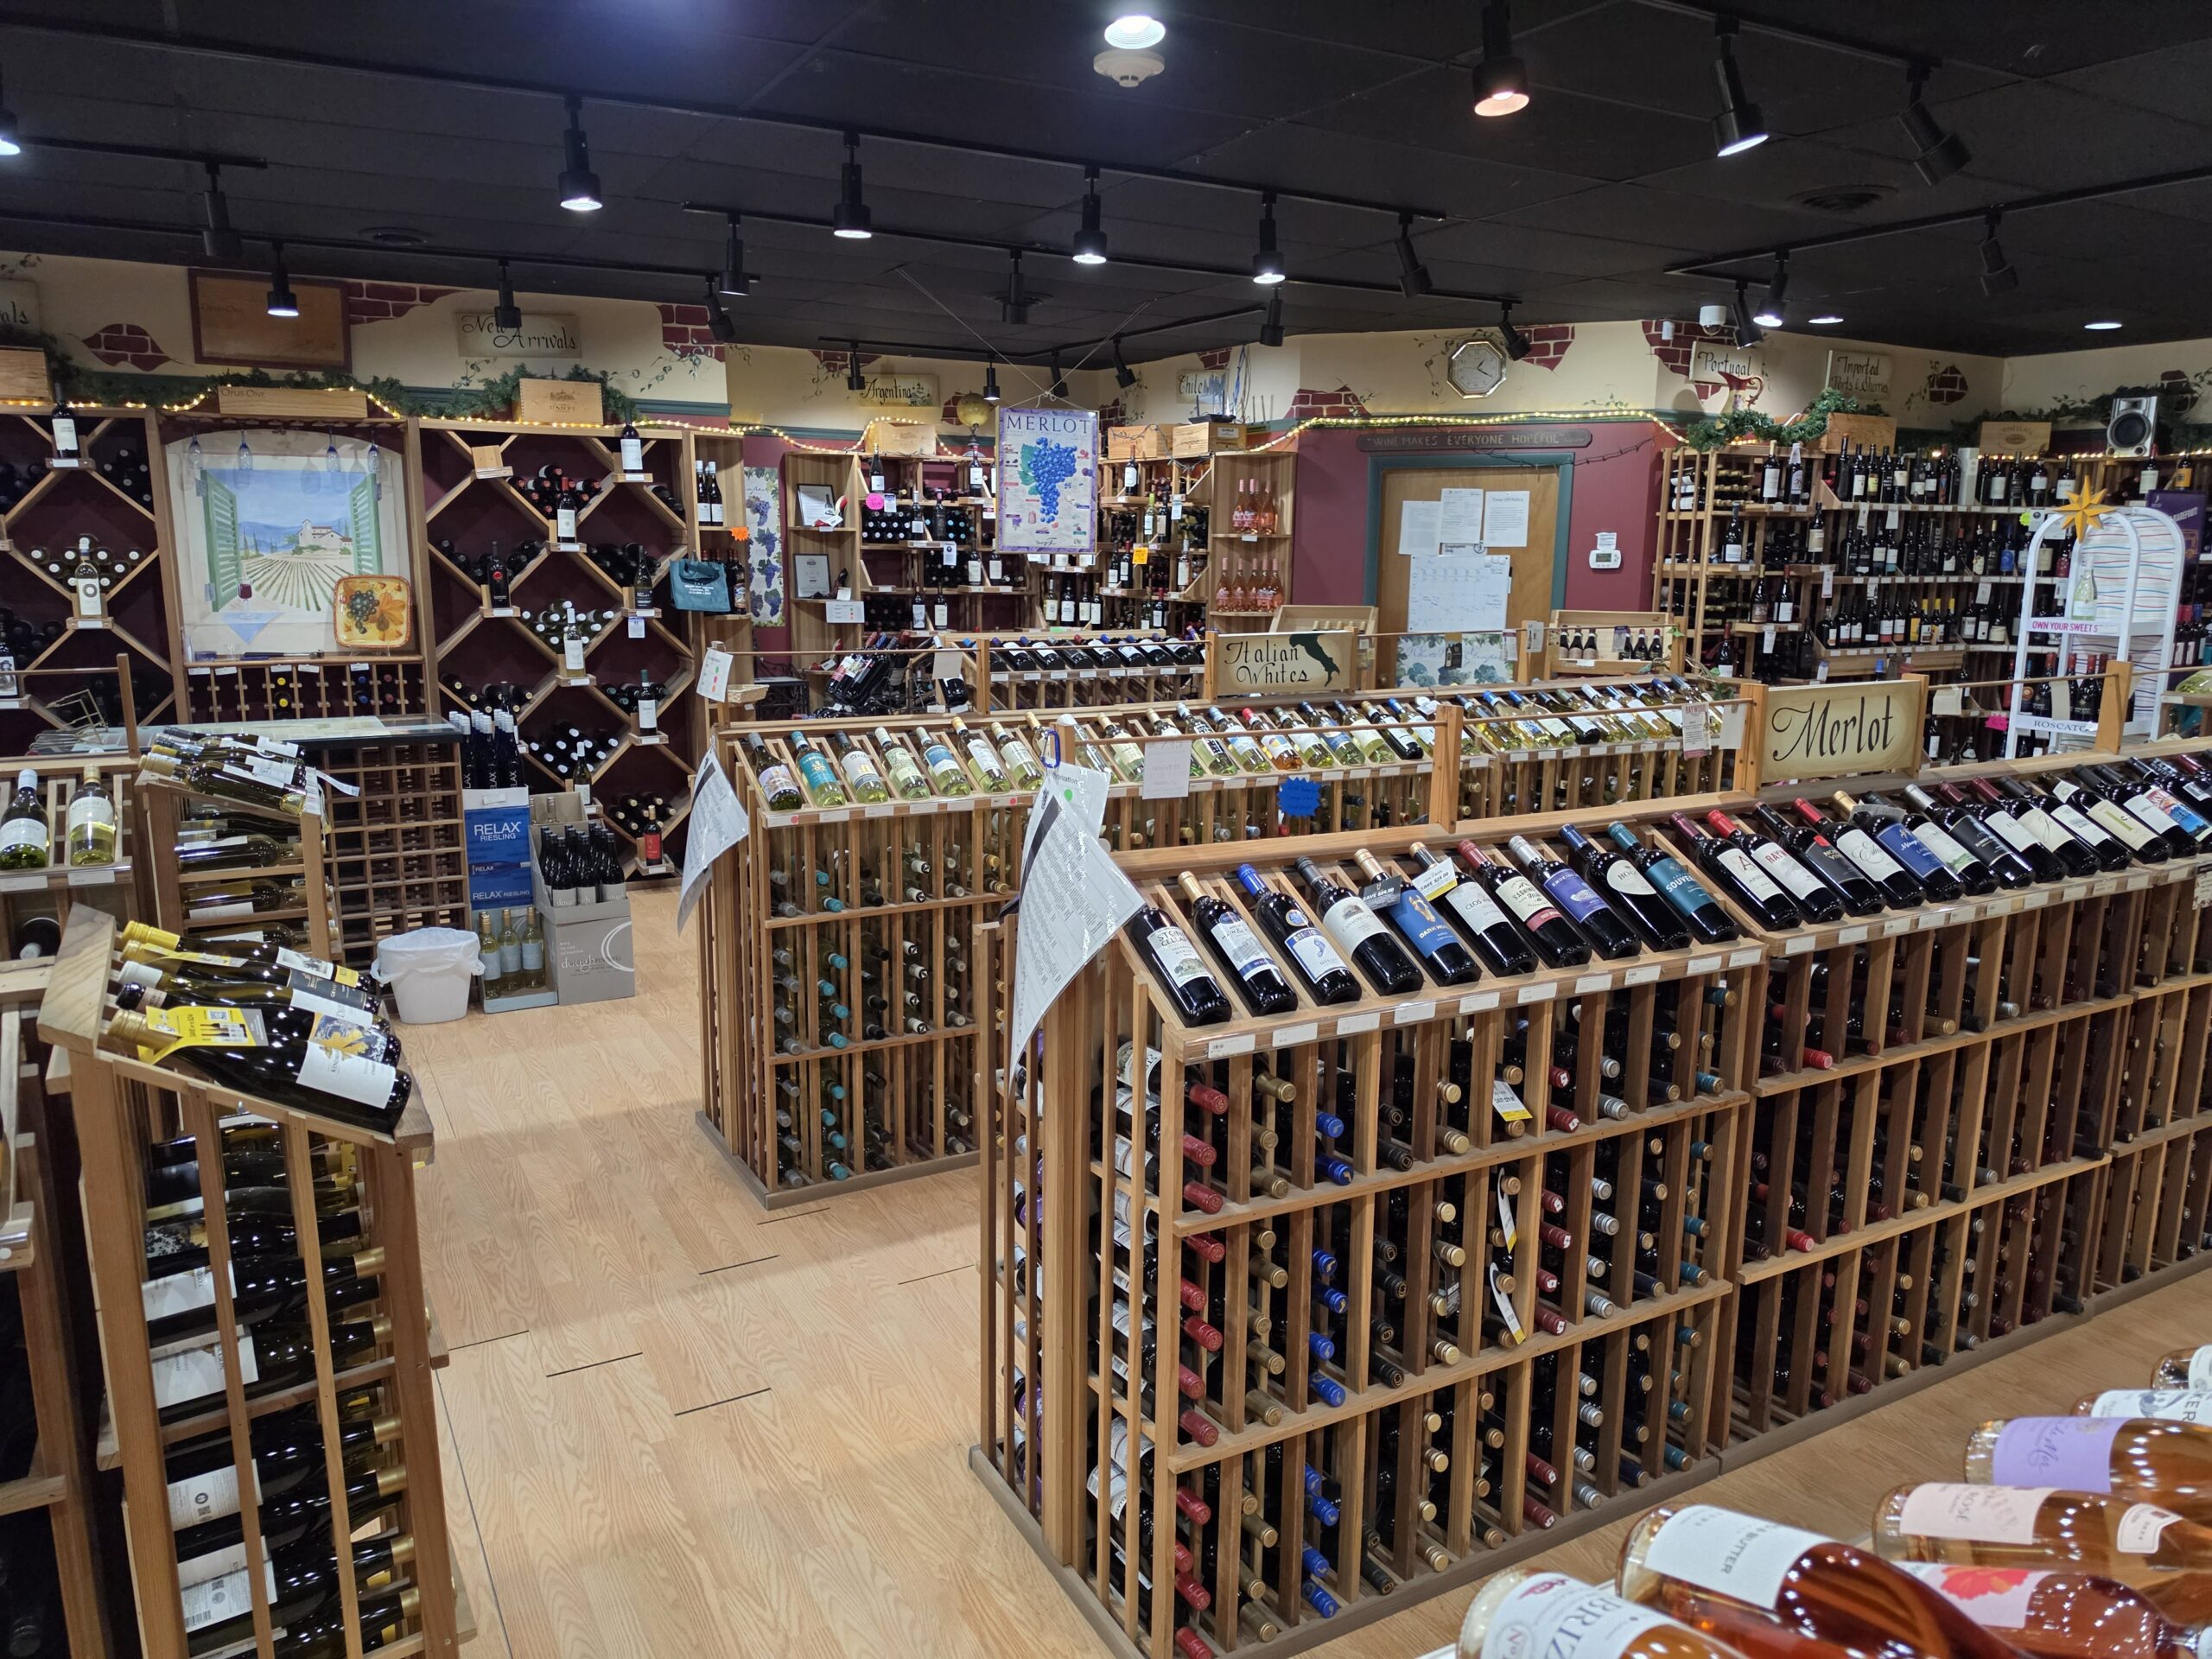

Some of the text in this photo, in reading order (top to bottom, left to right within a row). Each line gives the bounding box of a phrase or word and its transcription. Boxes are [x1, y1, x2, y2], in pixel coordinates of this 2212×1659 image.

[493, 325, 578, 349] Arrivals
[1697, 351, 1751, 377] Portugal
[1837, 355, 1879, 377] Imported
[859, 378, 912, 405] Argentina
[1179, 373, 1204, 395] Chile
[1007, 414, 1090, 435] MERLOT
[1402, 435, 1438, 446] MAKES
[1447, 434, 1504, 447] EVERYONE
[2032, 620, 2049, 629] OWN
[2050, 622, 2068, 631] YOUR
[2069, 624, 2091, 632] SWEET
[1224, 639, 1300, 664] Italian
[1236, 662, 1311, 684] Whites
[1771, 695, 1895, 761] Merlot
[474, 821, 522, 836] RELAX
[480, 832, 517, 842] RIESLING
[473, 889, 531, 900] RELAX RIESLING
[1465, 899, 1483, 912] CLOS
[1419, 925, 1437, 939] DARK
[561, 954, 596, 972] dough
[1719, 1531, 1759, 1575] BUTTER
